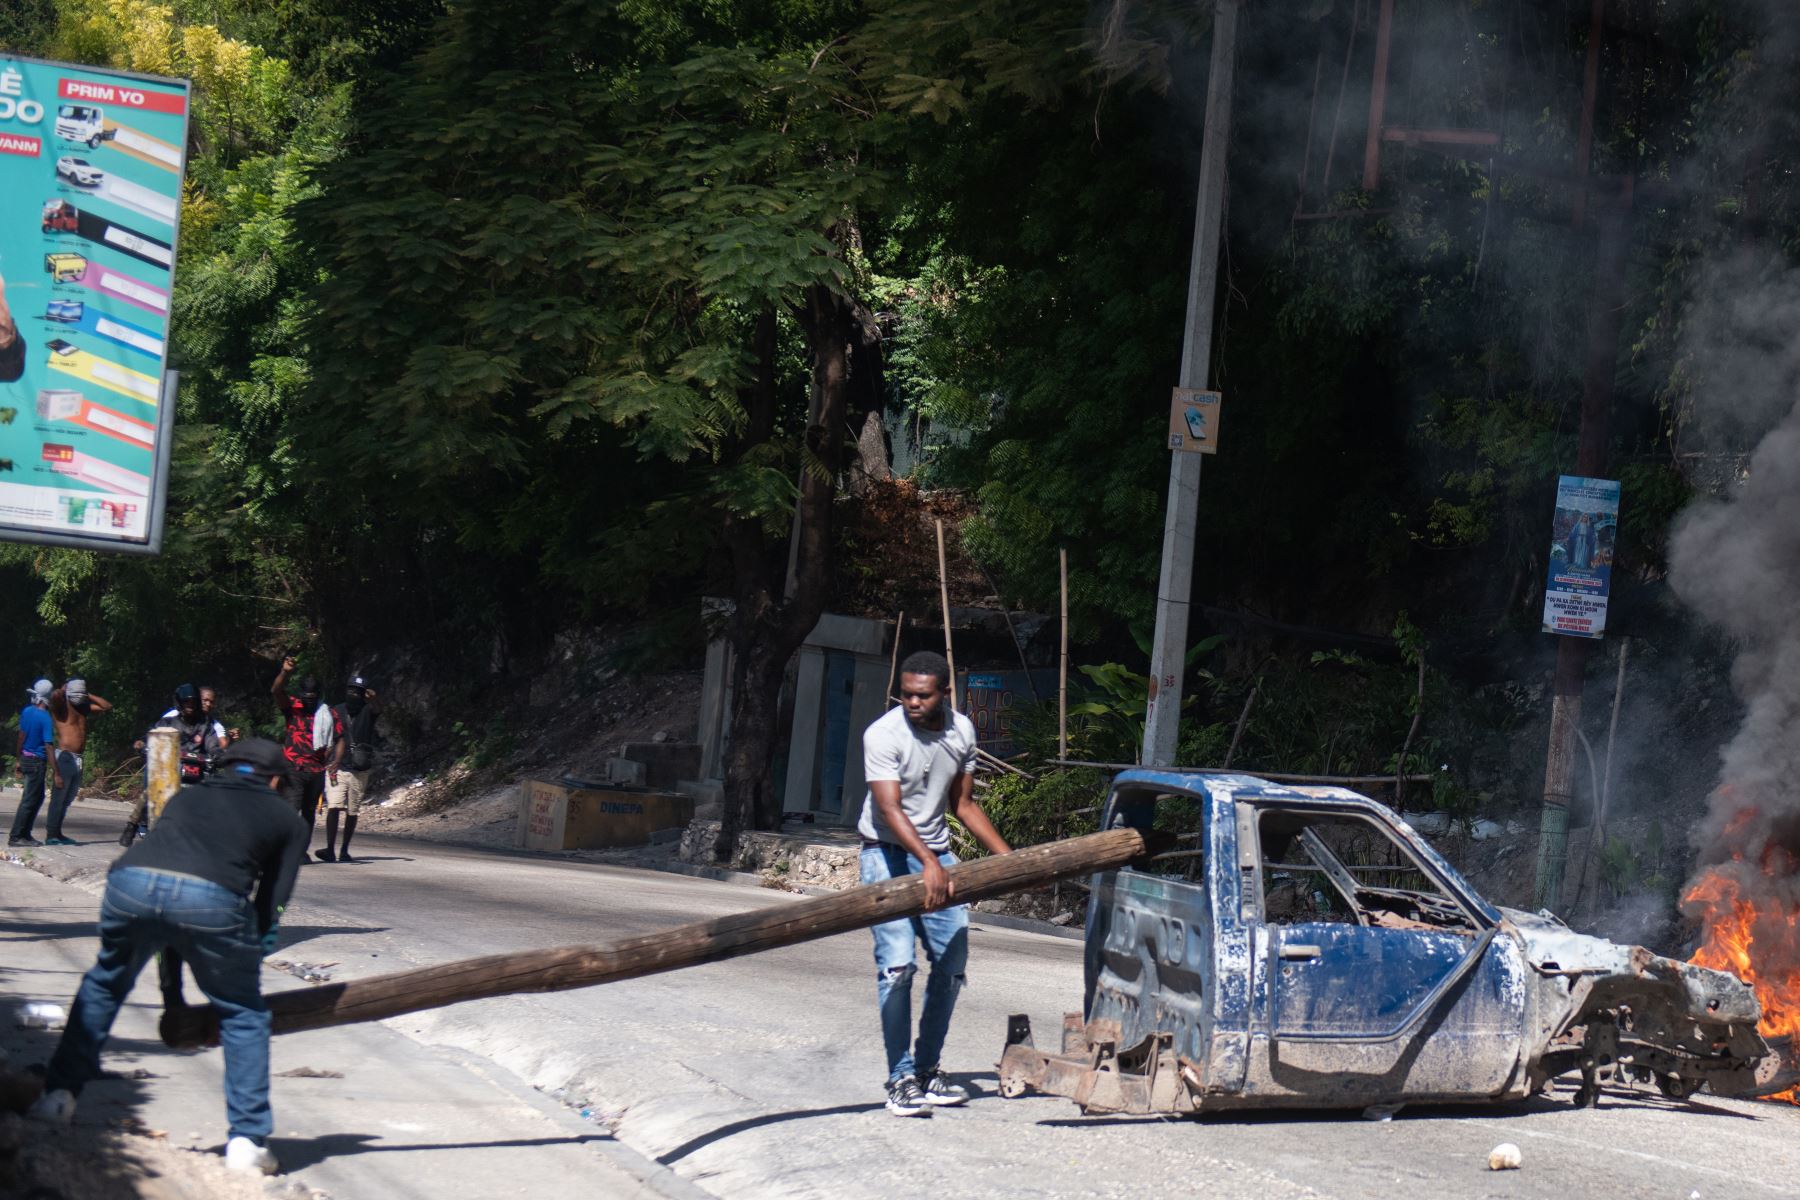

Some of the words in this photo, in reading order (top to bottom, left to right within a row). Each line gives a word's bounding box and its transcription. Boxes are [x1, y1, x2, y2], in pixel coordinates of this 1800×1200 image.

[66, 82, 115, 101] PRIM
[118, 89, 145, 105] YO
[1175, 391, 1218, 404] natcash
[966, 688, 1013, 707] AUTO
[600, 801, 644, 815] DINEPA
